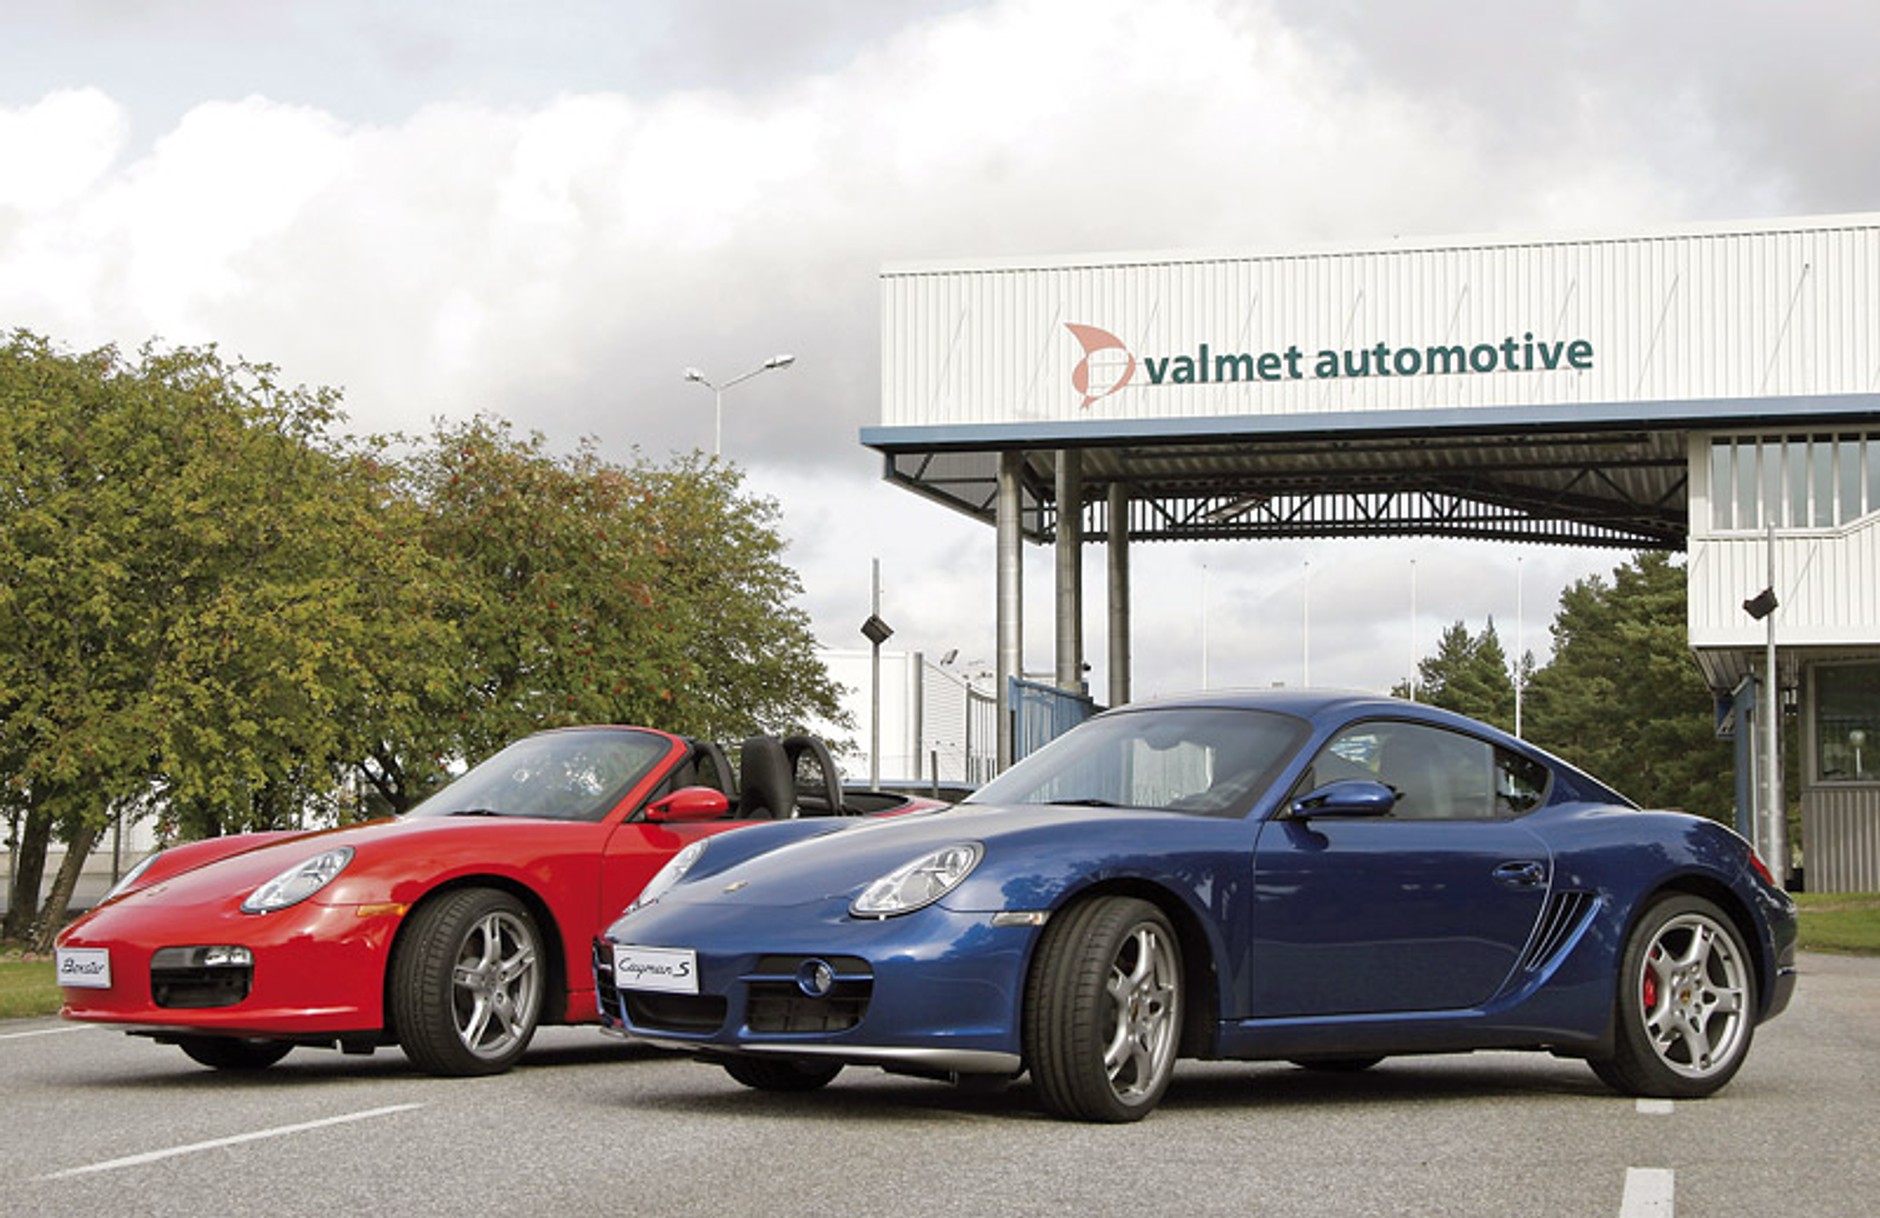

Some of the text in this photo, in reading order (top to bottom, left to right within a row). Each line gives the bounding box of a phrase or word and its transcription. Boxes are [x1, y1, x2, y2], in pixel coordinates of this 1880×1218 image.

[1144, 332, 1594, 385] valmet automotive
[618, 957, 690, 980] Cayman S
